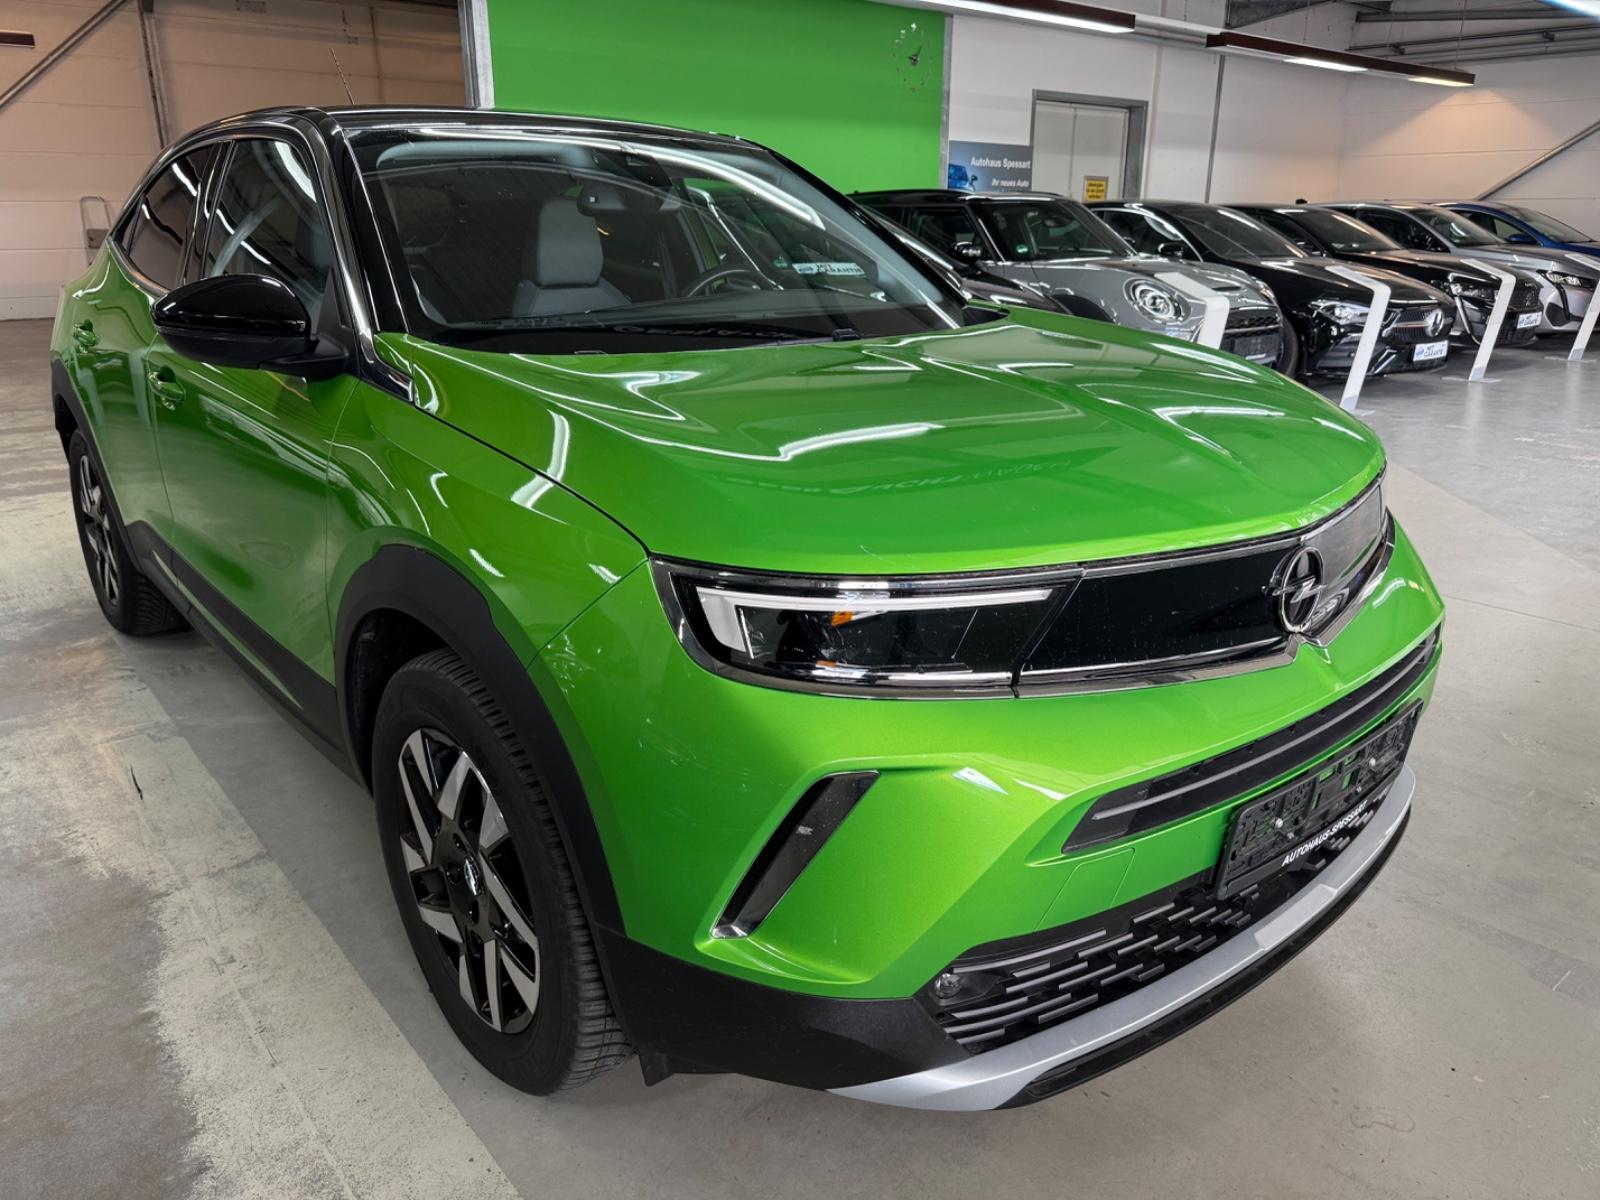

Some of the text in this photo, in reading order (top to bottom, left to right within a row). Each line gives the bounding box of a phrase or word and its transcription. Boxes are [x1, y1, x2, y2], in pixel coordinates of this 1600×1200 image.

[971, 157, 1030, 169] Autohaus Spessart
[992, 178, 1000, 186] Ihr
[1017, 179, 1030, 187] Auto
